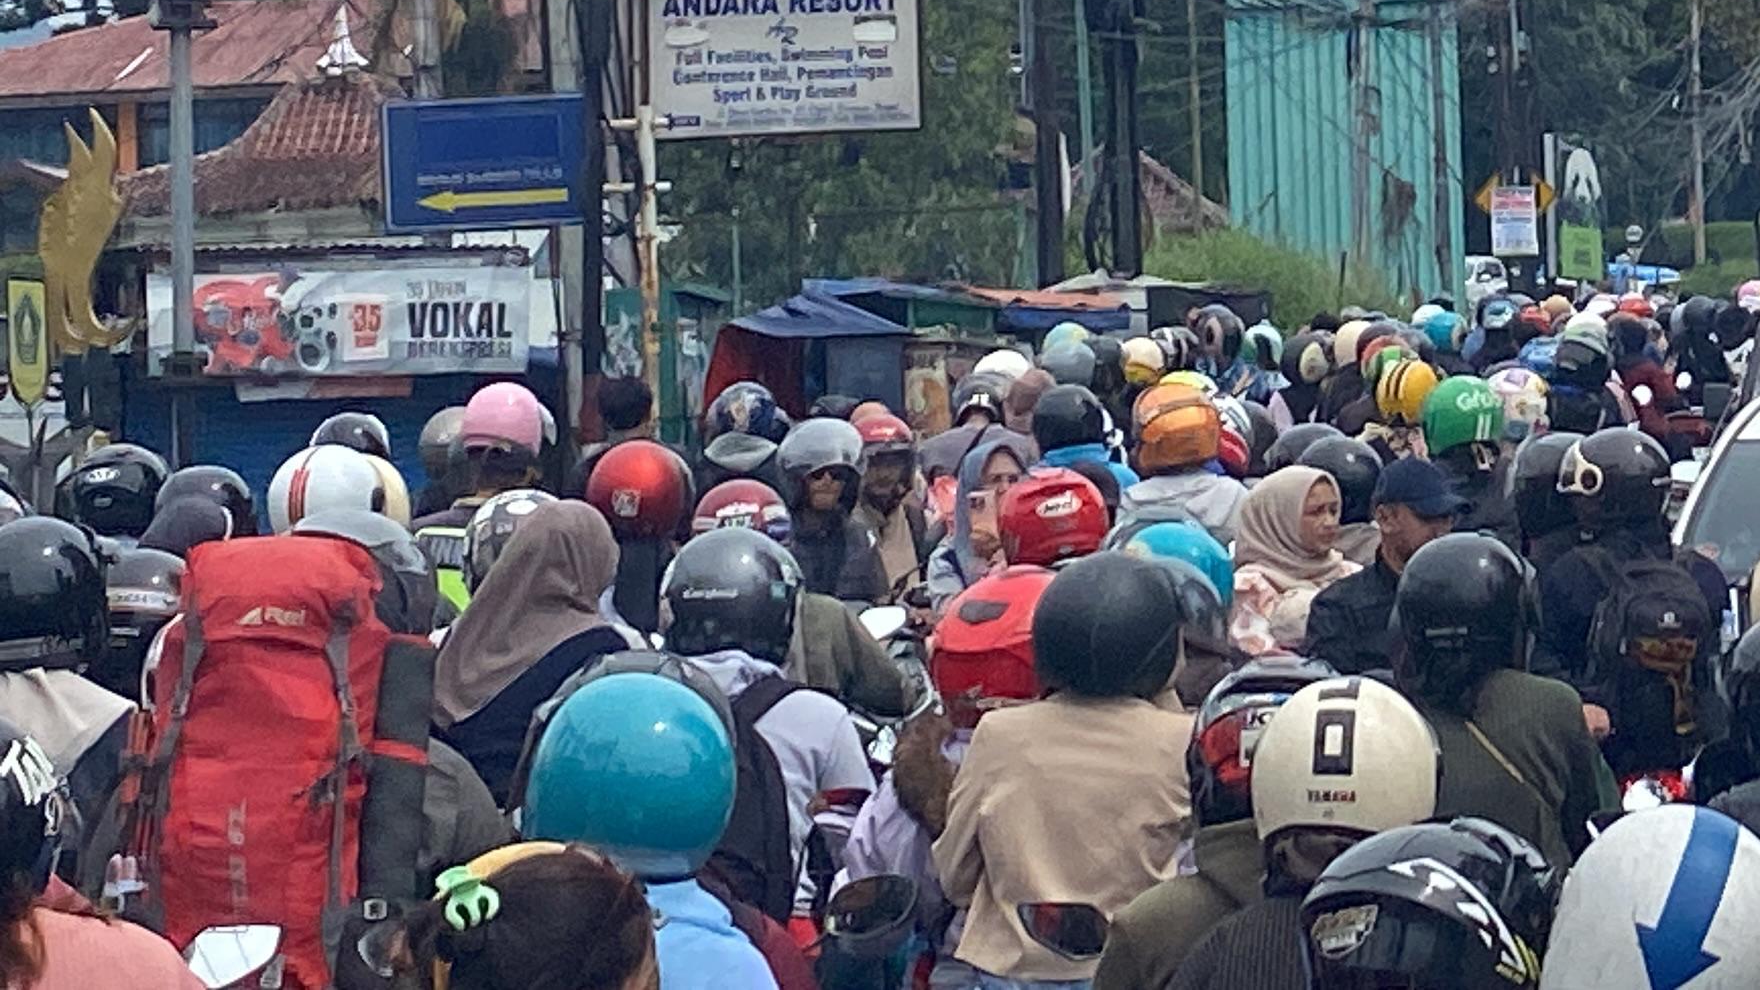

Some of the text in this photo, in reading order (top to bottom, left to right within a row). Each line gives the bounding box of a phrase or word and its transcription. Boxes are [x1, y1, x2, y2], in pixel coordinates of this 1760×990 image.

[713, 83, 857, 104] Sport & Play Ground
[407, 301, 513, 339] VOKAL
[1306, 789, 1357, 803] YAMAHA
